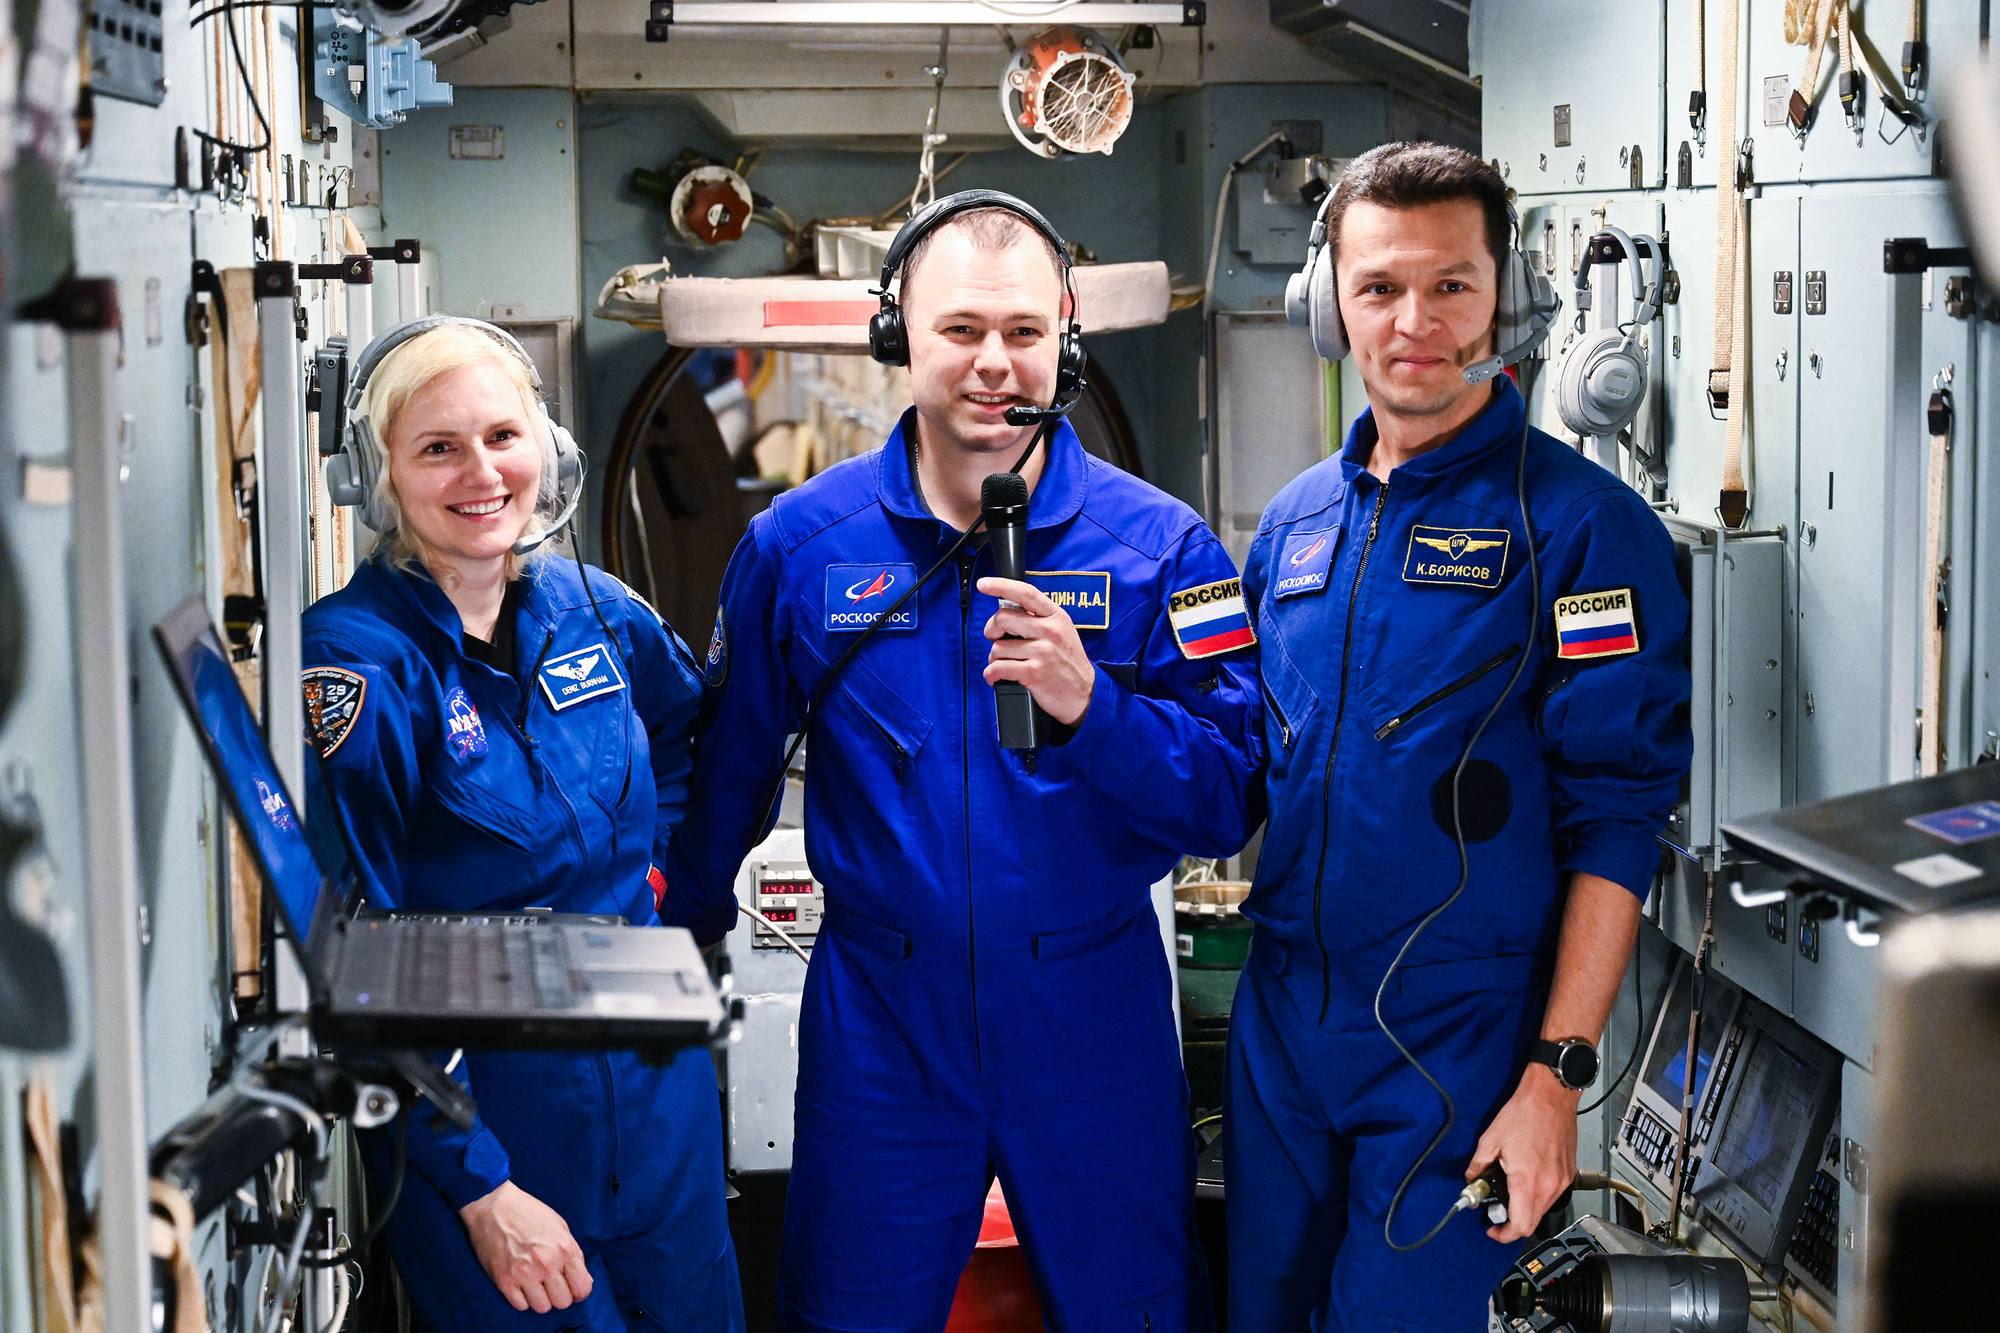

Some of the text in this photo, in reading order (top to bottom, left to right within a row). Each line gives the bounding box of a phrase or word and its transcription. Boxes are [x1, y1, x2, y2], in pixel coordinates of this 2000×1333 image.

[1416, 562, 1490, 579] К.БОРИСОВ
[1279, 572, 1323, 591] РОСКОСМОС
[1078, 591, 1105, 608] Д.А.
[1170, 581, 1241, 612] РОССИЯ
[1558, 594, 1627, 617] РОССИЯ
[326, 684, 347, 696] 29
